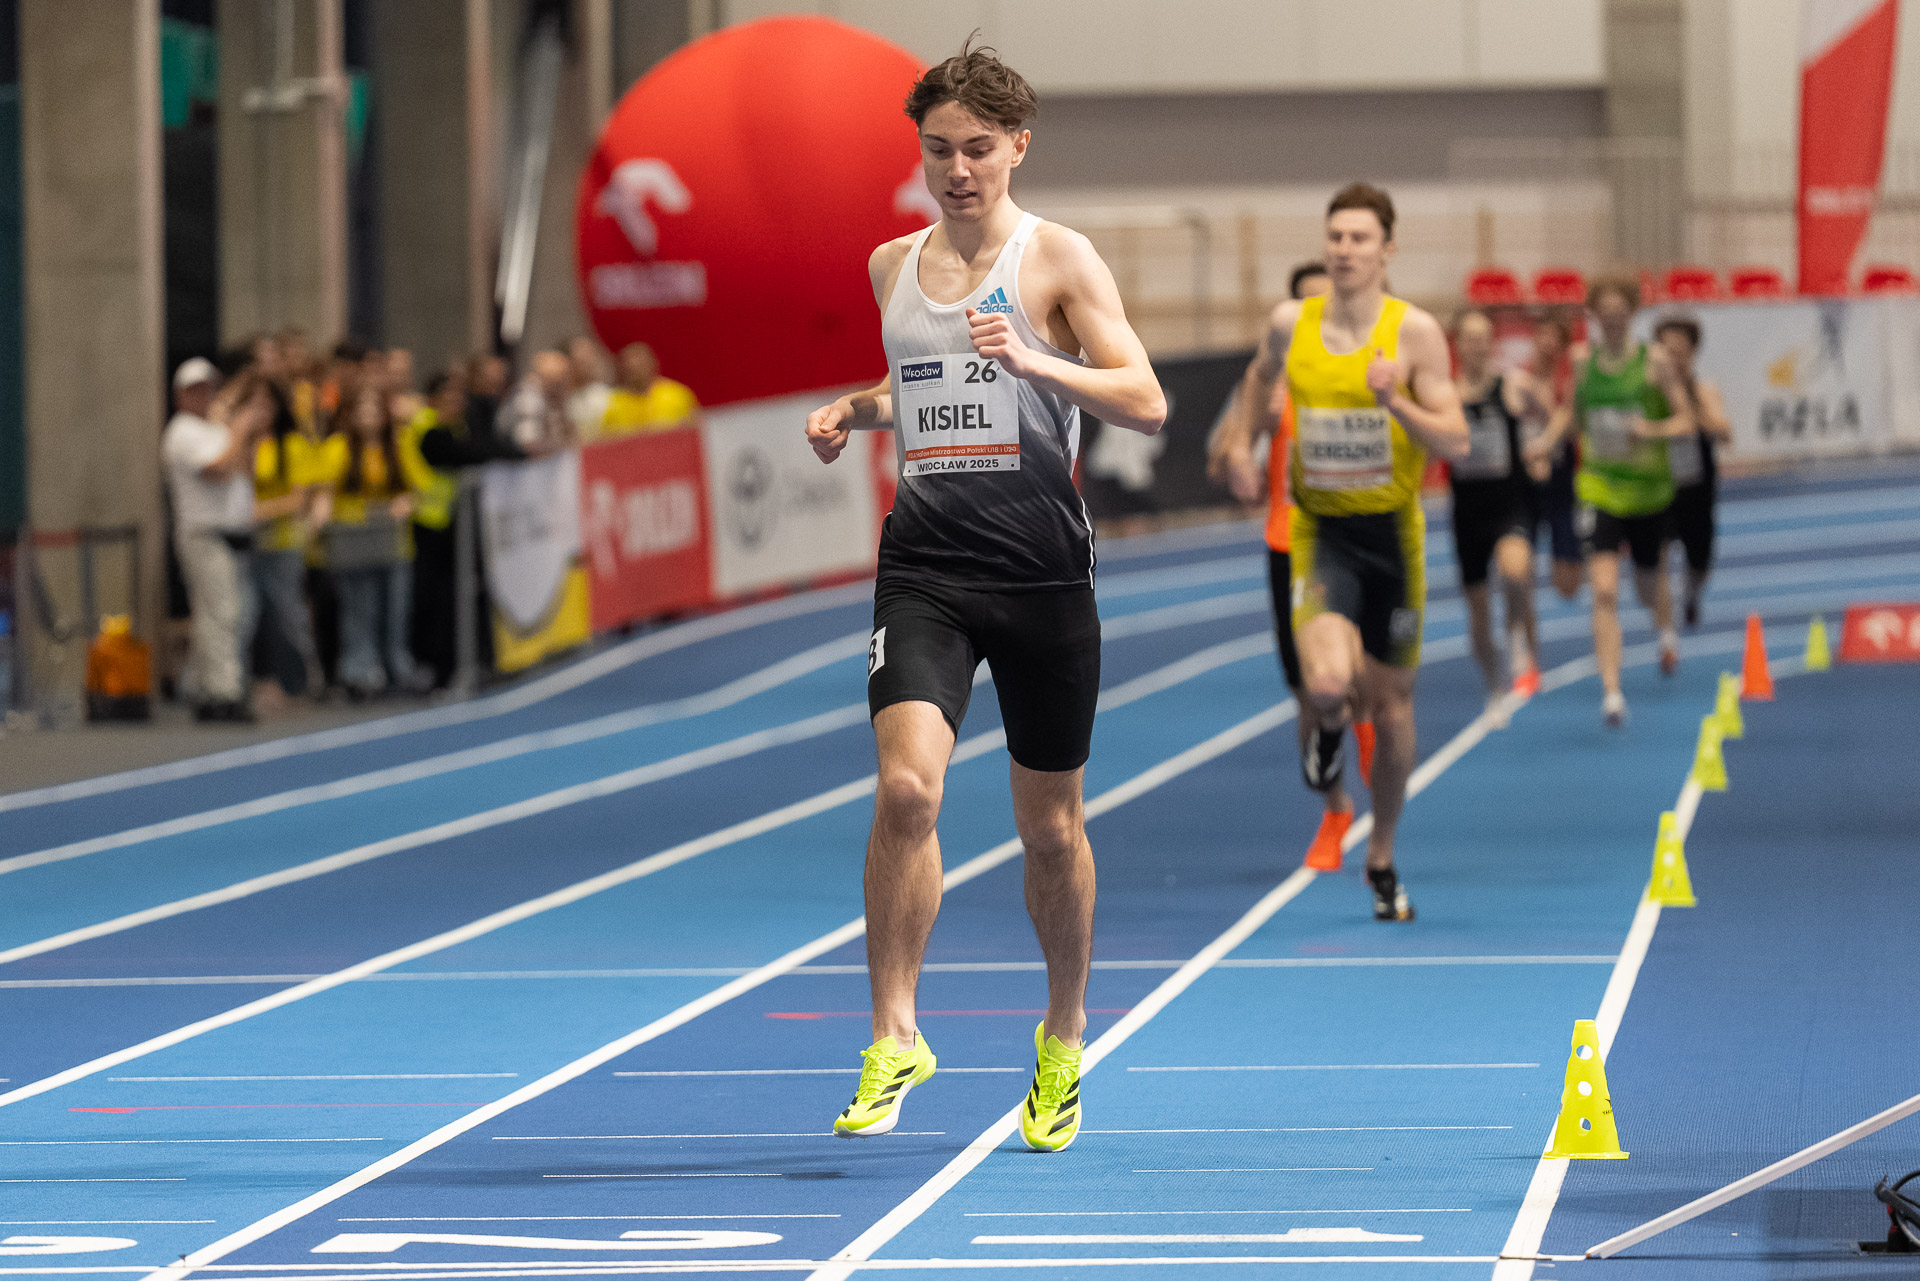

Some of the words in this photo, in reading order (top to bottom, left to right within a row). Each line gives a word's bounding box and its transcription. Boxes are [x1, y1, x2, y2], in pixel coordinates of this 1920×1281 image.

[976, 303, 1014, 314] adidas
[965, 360, 997, 384] 26
[918, 404, 992, 433] KISIEL
[930, 448, 966, 456] Mistrzostwa
[967, 446, 987, 454] Polski
[917, 460, 967, 472] WROCŁAW
[970, 459, 999, 469] 2025
[310, 1230, 784, 1253] 2
